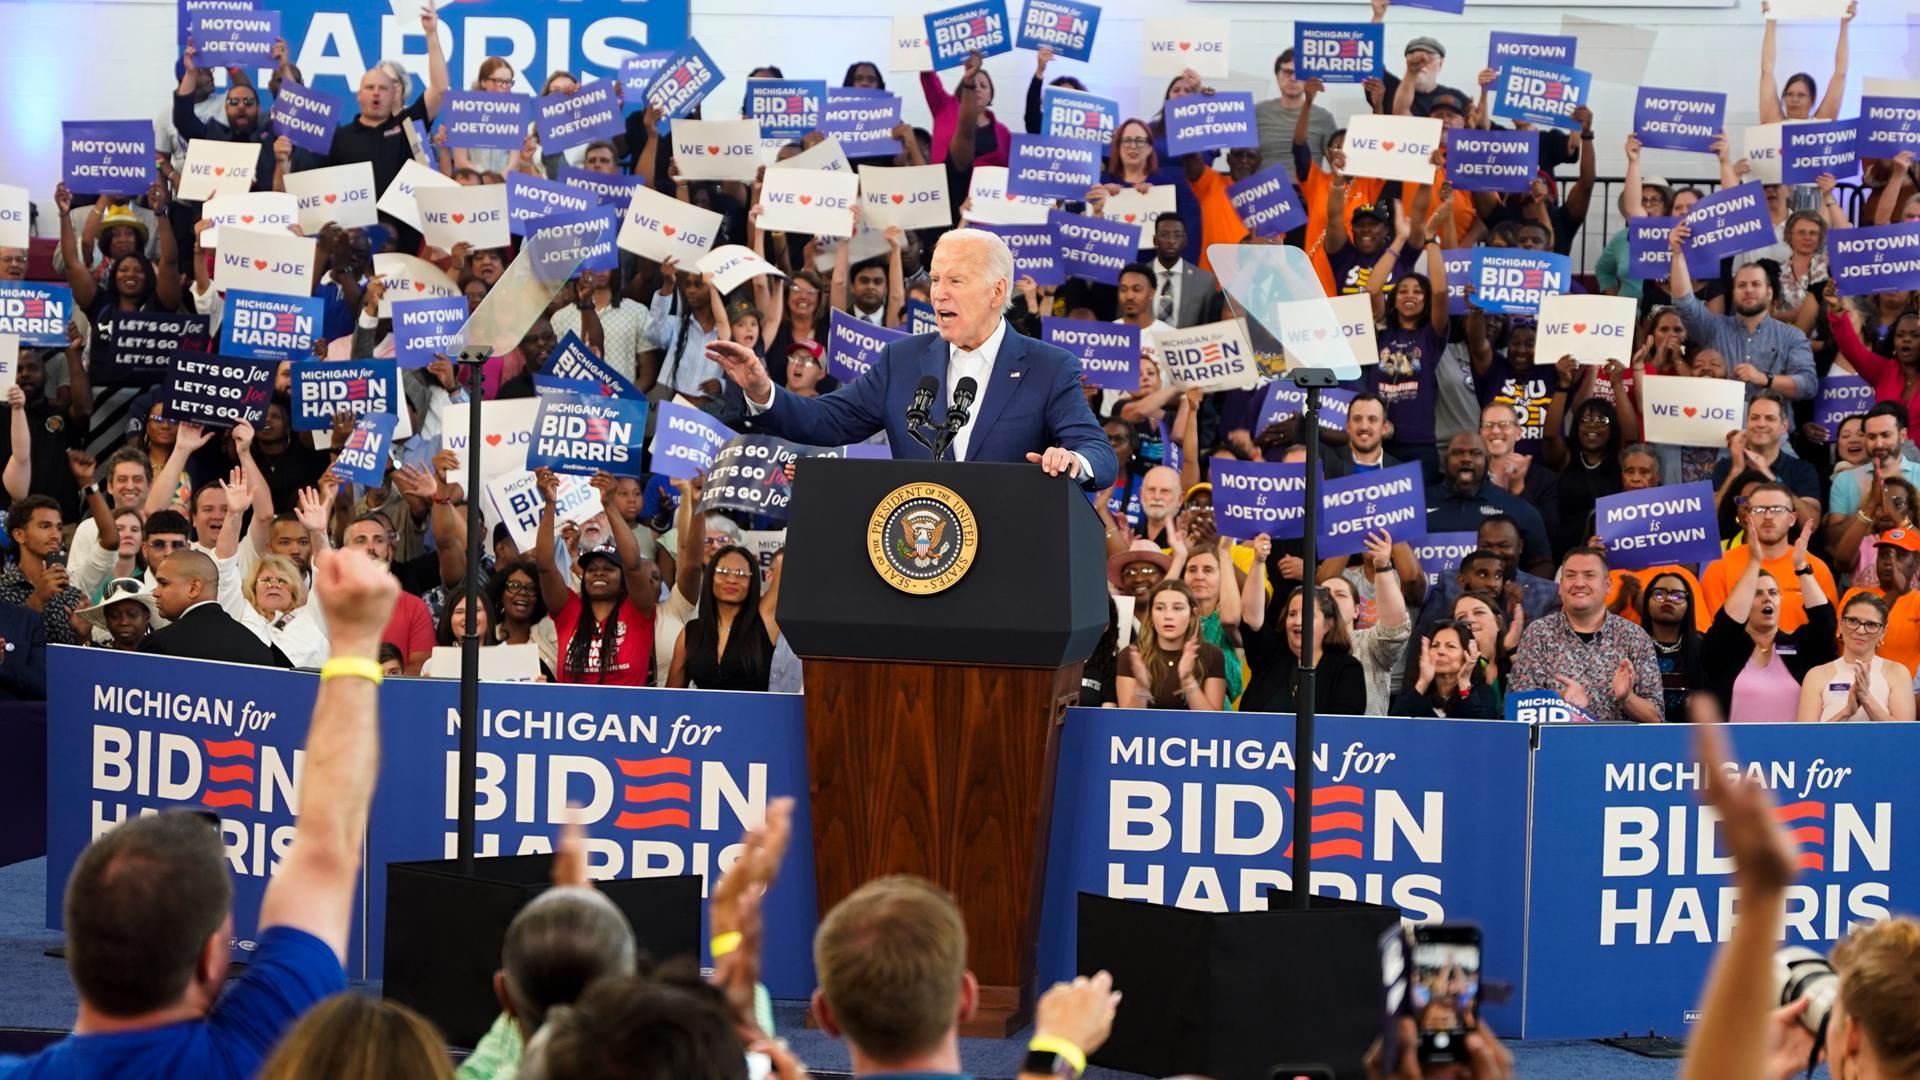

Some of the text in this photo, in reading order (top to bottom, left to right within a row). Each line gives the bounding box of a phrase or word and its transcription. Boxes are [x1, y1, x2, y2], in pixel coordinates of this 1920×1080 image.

[202, 19, 270, 31] MOTOWN
[935, 13, 1001, 43] BIDEN
[1027, 8, 1089, 35] BIDEN
[898, 38, 921, 48] WE
[1024, 24, 1085, 49] HARRIS
[1303, 29, 1364, 40] MICHIGAN for
[202, 41, 270, 53] JOETOWN
[938, 31, 1003, 58] HARRIS
[1151, 41, 1222, 52] WE JOE
[1303, 40, 1373, 57] BIDEN
[1497, 43, 1566, 57] MOTOWN
[1303, 57, 1373, 72] HARRIS
[1511, 65, 1557, 81] MICHIGAN
[753, 87, 795, 96] MICHIGAN
[1507, 78, 1579, 101] BIDEN
[451, 100, 520, 114] MOTOWN
[542, 89, 607, 118] MOTOWN
[753, 97, 819, 113] BIDEN
[1173, 100, 1245, 118] MOTOWN
[1505, 92, 1576, 116] HARRIS
[1645, 98, 1715, 115] MOTOWN
[754, 113, 818, 127] HARRIS
[825, 107, 893, 121] MOTOWN
[1051, 108, 1113, 130] BIDEN
[451, 122, 519, 135] JOETOWN
[549, 110, 613, 139] JOETOWN
[1050, 123, 1113, 144] HARRIS
[1176, 121, 1248, 138] JOETOWN
[1642, 120, 1713, 136] JOETOWN
[828, 128, 893, 142] JOETOWN
[1791, 129, 1857, 146] MOTOWN
[72, 140, 144, 154] MOTOWN
[680, 143, 754, 156] WE JOE
[1020, 144, 1092, 163] MOTOWN
[1352, 138, 1430, 156] WE JOE
[1456, 140, 1529, 153] MOTOWN
[1750, 148, 1775, 159] WE
[1792, 152, 1855, 168] JOETOWN
[71, 164, 145, 177] JOETOWN
[190, 163, 249, 177] WE JOE
[1017, 167, 1091, 185] JOETOWN
[1455, 163, 1529, 176] JOETOWN
[298, 188, 369, 209] WE JOE
[514, 184, 587, 211] MOTOWN
[769, 192, 847, 209] WE JOE
[867, 189, 941, 204] WE JOE
[976, 188, 1001, 199] WE
[209, 214, 291, 224] WE JOE
[425, 212, 448, 223] WE
[469, 210, 500, 223] JOE
[1685, 195, 1756, 225] MOTOWN
[537, 217, 609, 239] MOTOWN
[633, 213, 707, 247] WE JOE
[1690, 219, 1762, 249] JOETOWN
[541, 241, 611, 263] JOETOWN
[1838, 235, 1920, 254] MOTOWN
[224, 253, 305, 276] WE JOE
[1483, 256, 1536, 268] MICHIGAN
[1536, 259, 1551, 270] for
[1840, 259, 1920, 279] JOETOWN
[384, 279, 410, 290] WE
[1481, 267, 1561, 289] BIDEN
[35, 290, 51, 301] for
[1480, 286, 1560, 303] HARRIS
[235, 299, 304, 314] MICHIGAN for
[119, 319, 180, 332] LET'S GO
[234, 310, 313, 333] BIDEN
[404, 308, 464, 325] MOTOWN
[232, 328, 311, 349] HARRIS
[1052, 330, 1130, 347] MOTOWN
[1545, 322, 1625, 337] WE JOE
[157, 338, 178, 349] GO
[405, 335, 464, 350] JOETOWN
[1164, 340, 1240, 367] BIDEN
[177, 360, 269, 384] LET'S GO Joe
[568, 342, 611, 385] MICHIGAN
[1170, 360, 1245, 381] HARRIS
[301, 368, 374, 380] MICHIGAN for
[174, 380, 266, 403] LET'S GO Joe
[301, 379, 387, 400] BIDEN
[171, 399, 215, 415] LET'S
[216, 406, 240, 419] GO
[240, 405, 263, 423] Joe
[302, 399, 387, 417] HARRIS
[546, 403, 619, 420] MICHIGAN for
[1651, 403, 1736, 421] WE JOE
[540, 415, 632, 444] BIDEN
[537, 439, 629, 462] HARRIS
[714, 445, 745, 462] LET'S
[745, 445, 769, 459] GO
[769, 444, 798, 464] Joe
[707, 465, 765, 482] LET'S GO
[1221, 473, 1307, 492] MOTOWN
[703, 486, 789, 508] LET'S GO Joe
[1323, 478, 1413, 509] MOTOWN
[1224, 503, 1306, 522] JOETOWN
[1607, 497, 1702, 523] MOTOWN
[1328, 506, 1416, 537] JOETOWN
[1648, 519, 1661, 532] is
[872, 487, 974, 589] SEAL OF THE PRESIDENT OF THE UNITED STATES
[1610, 527, 1706, 551] JOETOWN
[93, 684, 276, 737] MICHIGAN for
[661, 714, 722, 755] for
[1110, 735, 1396, 782] MICHIGAN for
[92, 724, 307, 816] BIDEN
[1604, 758, 1852, 799] MICHIGAN for
[445, 751, 768, 833] BIDEN
[1108, 780, 1445, 863] BIDEN
